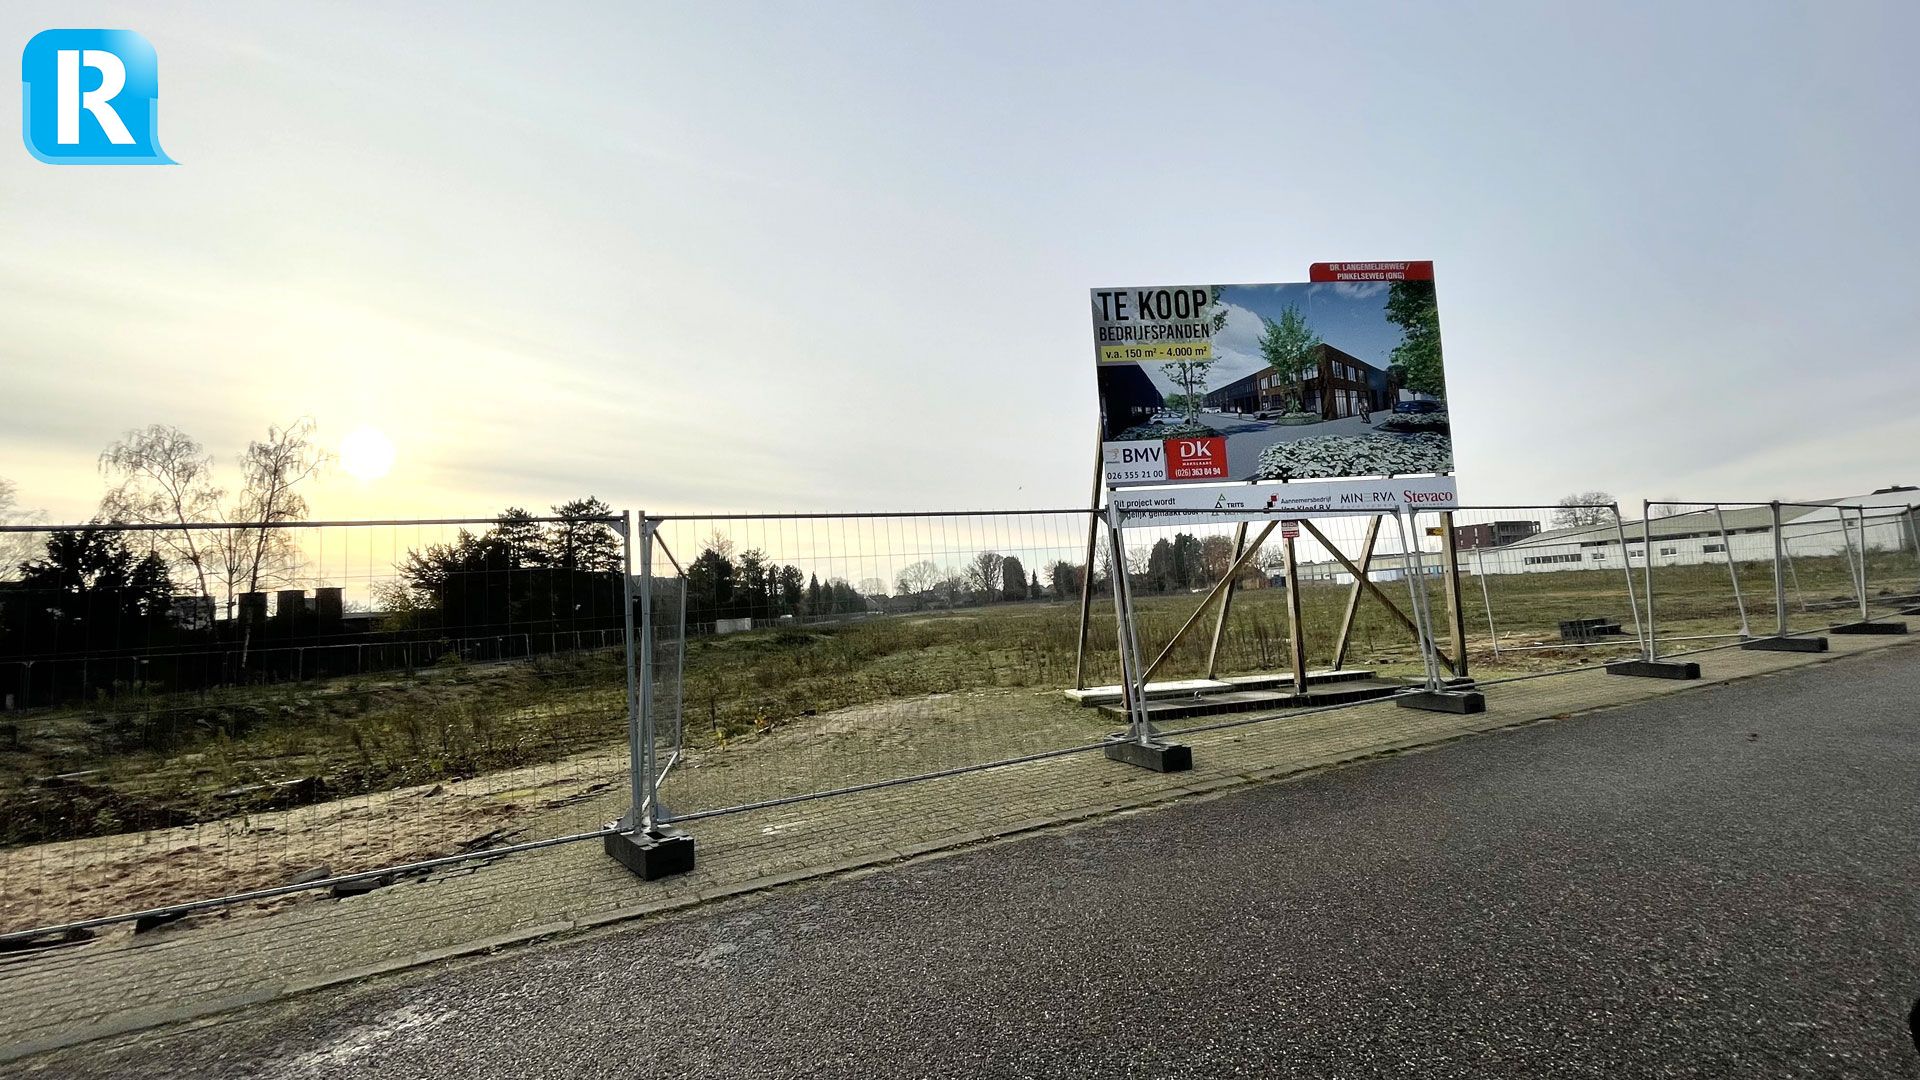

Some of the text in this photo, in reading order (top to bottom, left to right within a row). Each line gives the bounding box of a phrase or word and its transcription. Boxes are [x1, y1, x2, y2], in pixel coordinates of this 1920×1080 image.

[1337, 272, 1385, 280] PINKELSEWEG
[1097, 289, 1208, 322] TE KOOP
[1099, 323, 1210, 342] BEDRIJFSPANDEN
[1105, 350, 1123, 359] v.a.
[1125, 348, 1142, 358] 150
[1166, 346, 1193, 357] 4.000
[1122, 447, 1161, 463] BMV
[1179, 440, 1212, 458] DK
[1107, 470, 1164, 480] 026 355 21 00
[1175, 468, 1191, 478] (026)
[1191, 467, 1203, 476] 363
[1126, 499, 1153, 508] project
[1154, 497, 1176, 506] wordt
[1340, 491, 1396, 504] MINERVA
[1403, 489, 1453, 503] Stevaco
